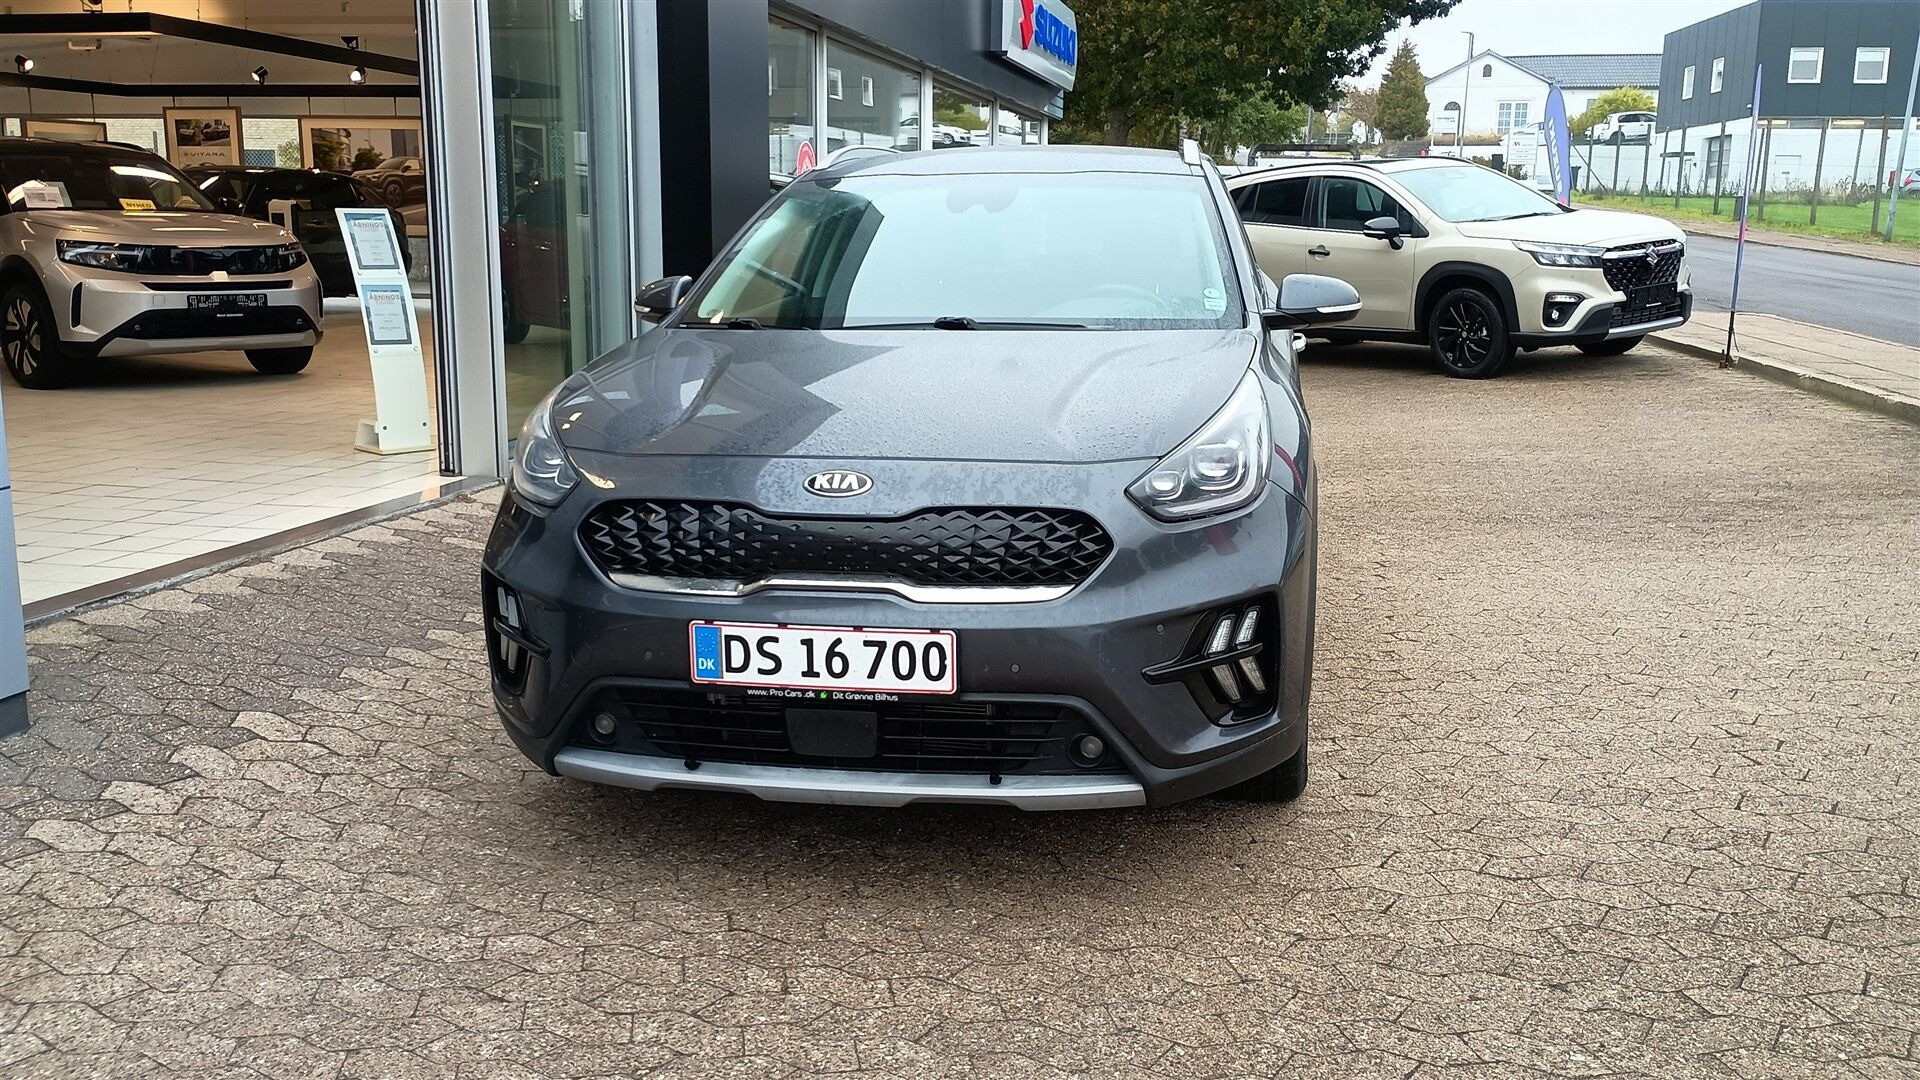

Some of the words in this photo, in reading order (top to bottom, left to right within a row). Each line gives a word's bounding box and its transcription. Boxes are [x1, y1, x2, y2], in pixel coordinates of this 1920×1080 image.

[1034, 4, 1076, 67] SUZUKI
[814, 473, 860, 490] KIA
[698, 657, 716, 671] DK
[724, 634, 783, 676] DS
[799, 637, 850, 680] 16
[862, 639, 948, 682] 700
[769, 689, 784, 697] Pro
[784, 689, 803, 698] Cars
[832, 691, 844, 700] Dit
[845, 692, 874, 701] Grønne
[874, 693, 899, 702] Bilhus
